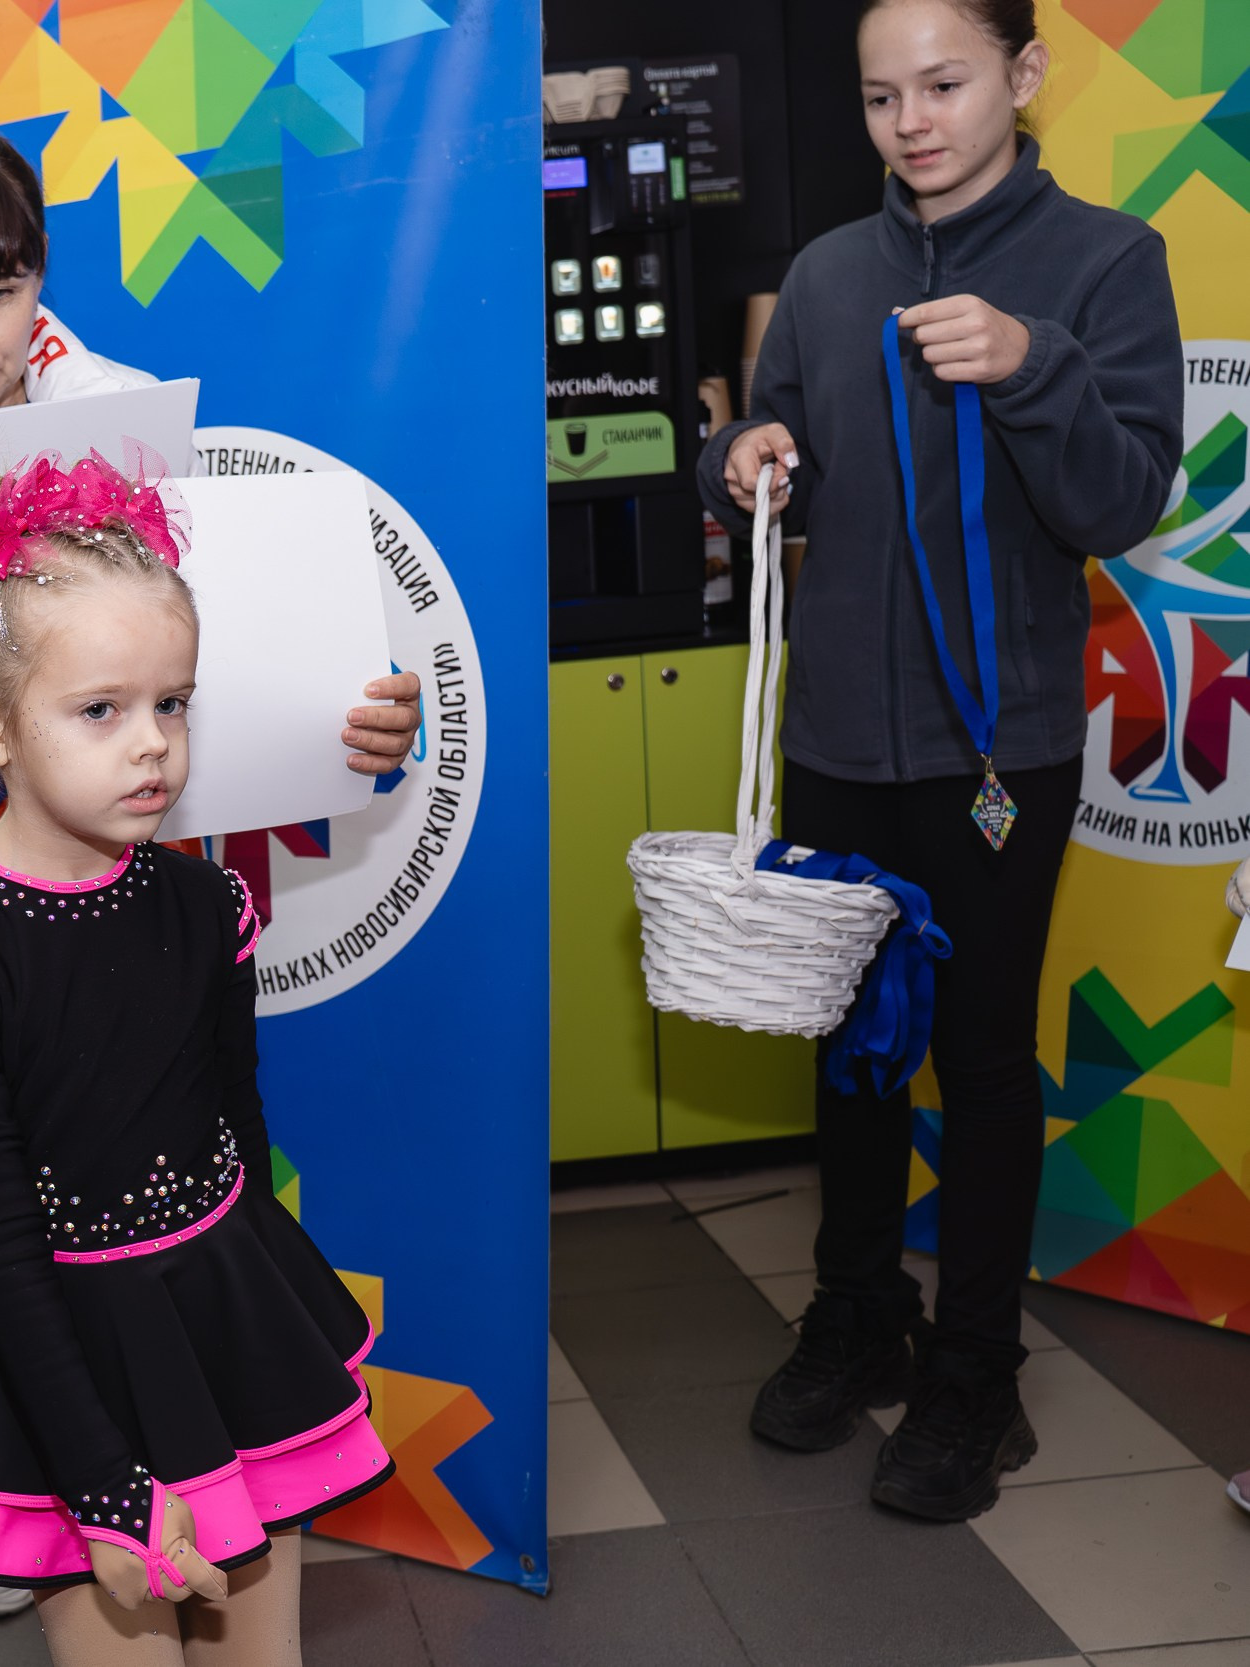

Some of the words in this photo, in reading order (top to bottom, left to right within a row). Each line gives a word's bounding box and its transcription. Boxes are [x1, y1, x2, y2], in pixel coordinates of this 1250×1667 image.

[602, 425, 664, 446] СТАКАНЧИК
[369, 508, 440, 614] ИЗАЦИЯ
[256, 948, 334, 997] НЬКАХ
[329, 786, 461, 969] НОВОСИБИРСКОЙ
[433, 643, 468, 782] ОБЛАСТИ»
[1142, 819, 1171, 847] НА
